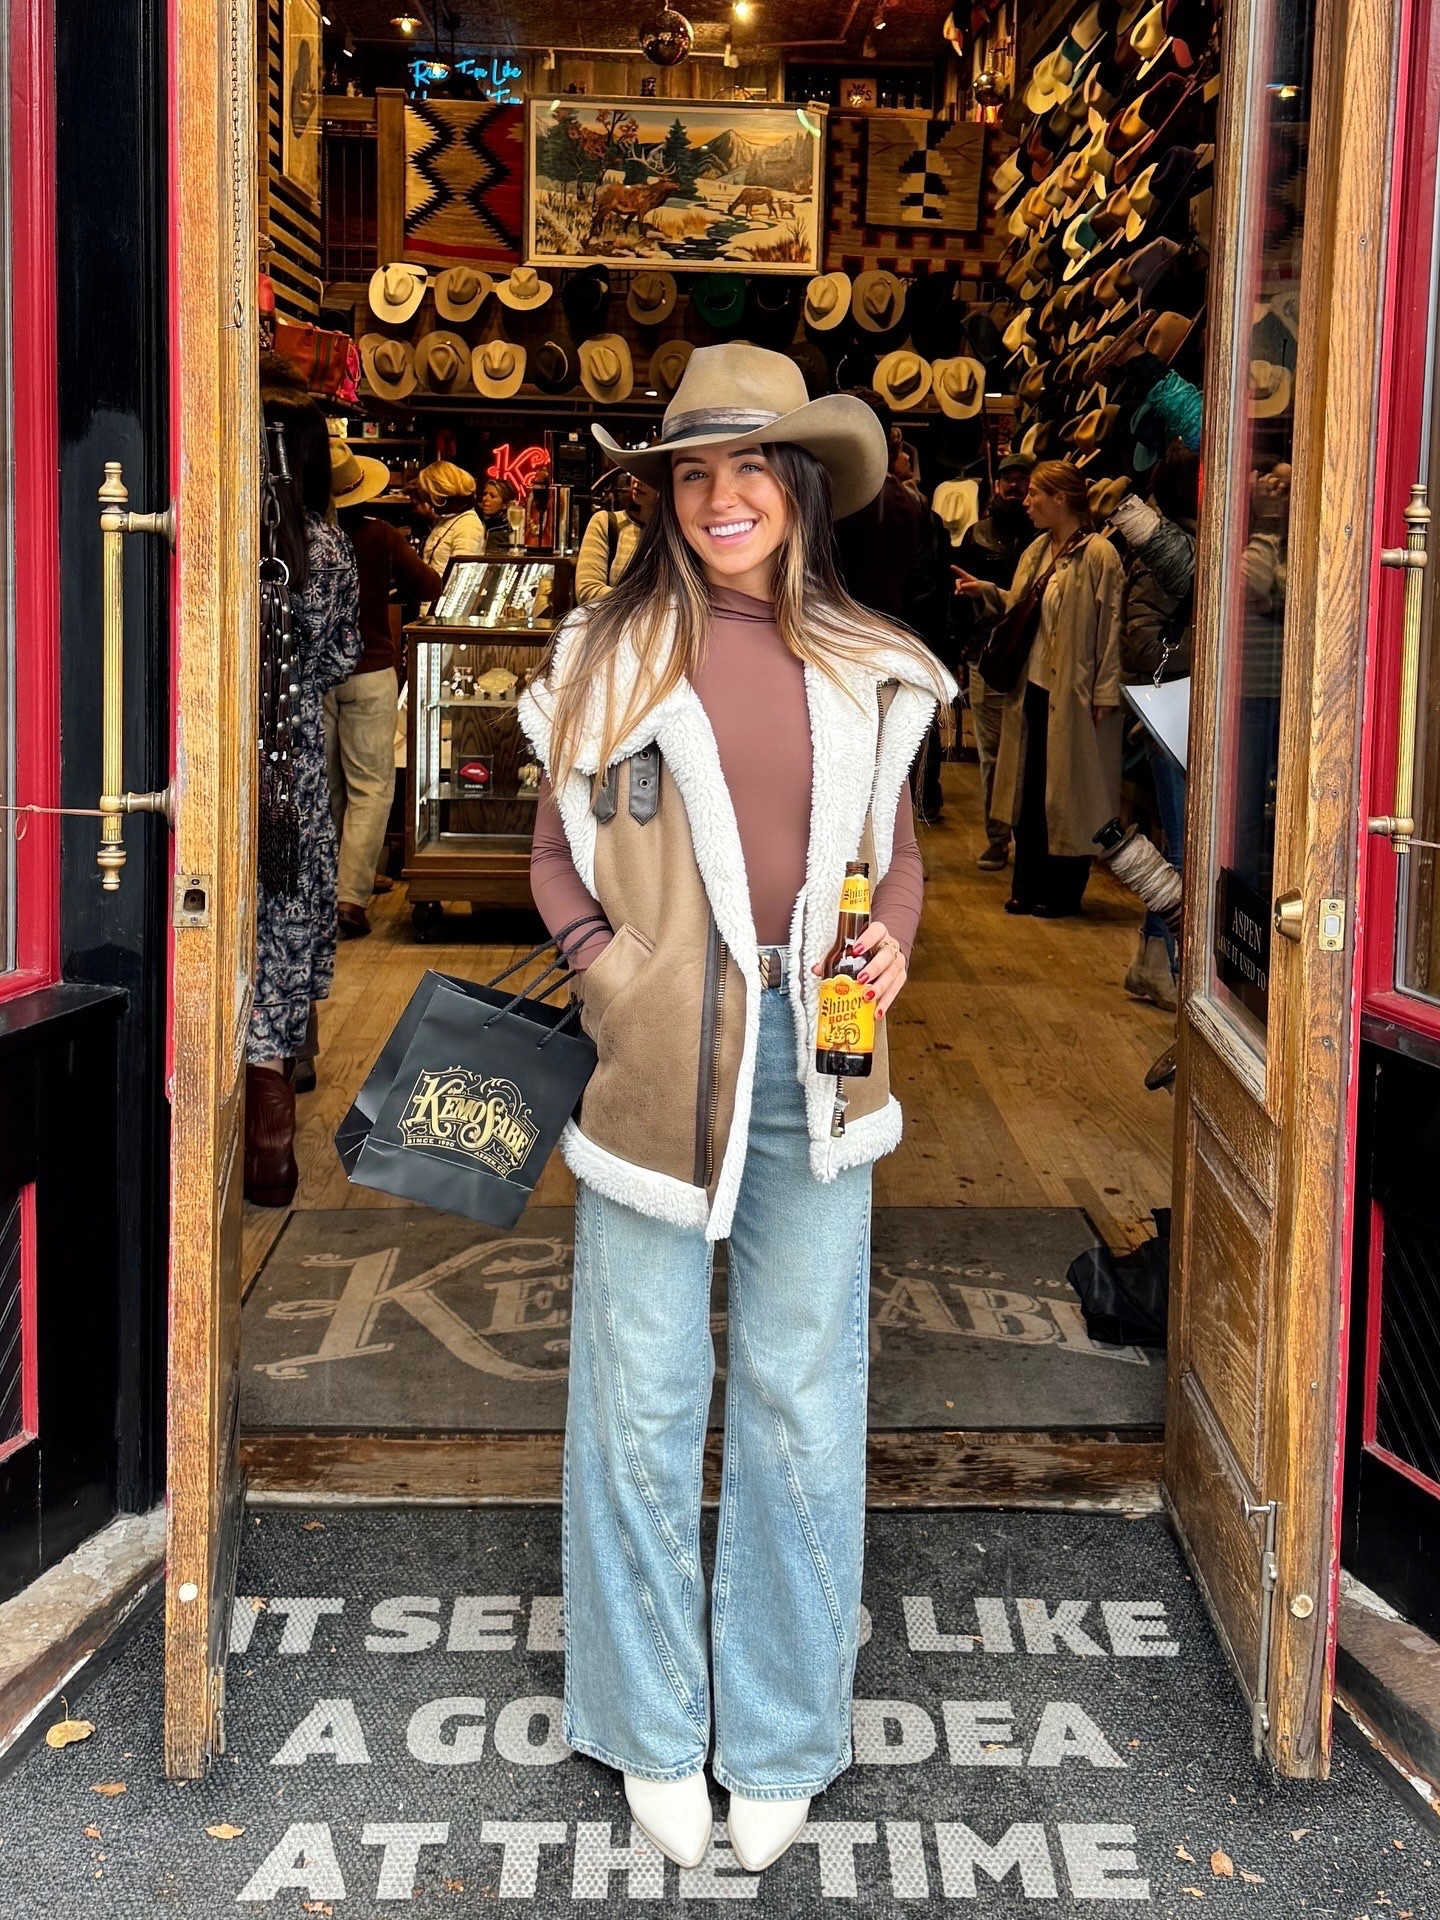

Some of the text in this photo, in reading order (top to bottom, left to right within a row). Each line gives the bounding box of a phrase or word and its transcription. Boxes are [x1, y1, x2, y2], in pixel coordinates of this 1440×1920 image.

[1231, 906, 1262, 954] ASPEN
[1256, 967, 1266, 991] TO
[828, 1011, 858, 1025] BOCK
[407, 1137, 435, 1145] SINCE
[229, 1596, 346, 1655] IT
[902, 1595, 1181, 1657] LIKE
[269, 1698, 373, 1766] A
[852, 1699, 1129, 1769] DEA
[235, 1820, 1151, 1902] AT THE TIME
